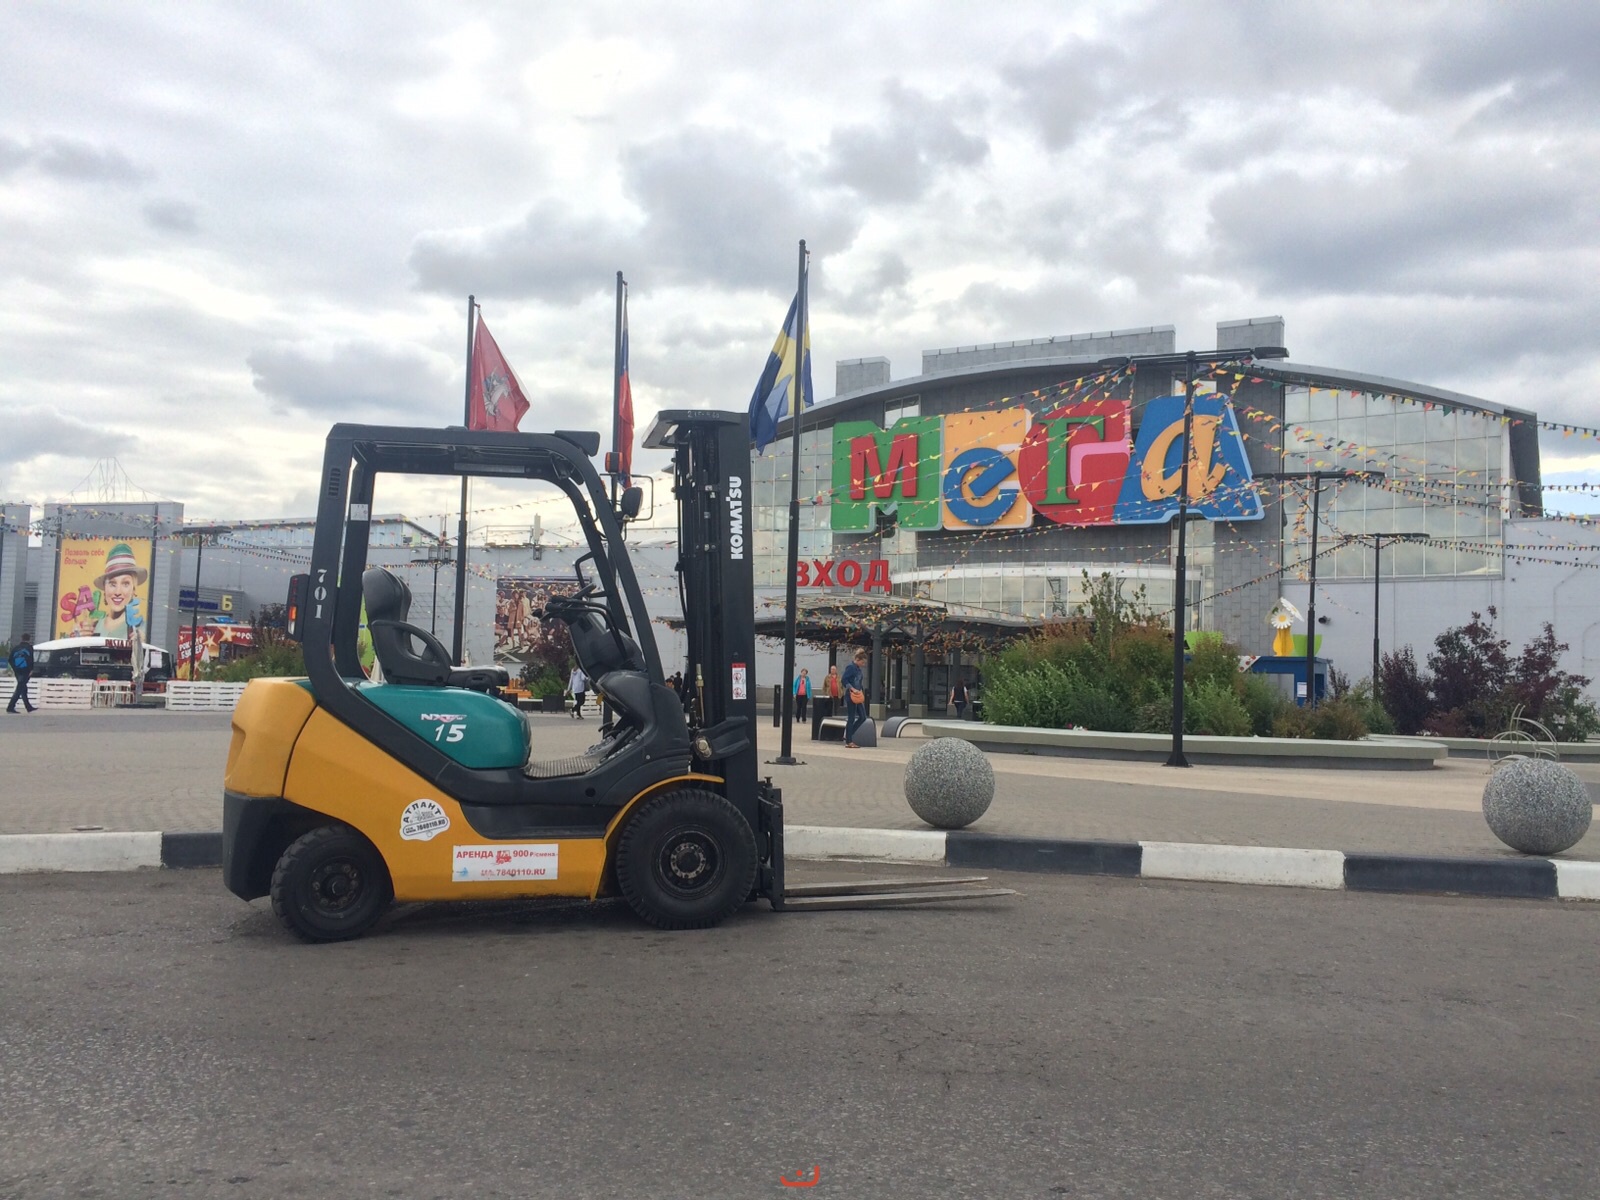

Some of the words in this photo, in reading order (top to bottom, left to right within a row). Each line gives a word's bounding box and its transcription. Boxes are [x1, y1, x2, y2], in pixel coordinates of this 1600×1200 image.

[728, 475, 744, 560] KOMATSU
[796, 559, 893, 592] ВХОД
[60, 585, 144, 627] SALE
[221, 594, 233, 611] Б
[313, 568, 328, 619] 701
[435, 723, 467, 742] 15
[456, 850, 494, 859] АРЕНДА
[512, 850, 529, 858] 900
